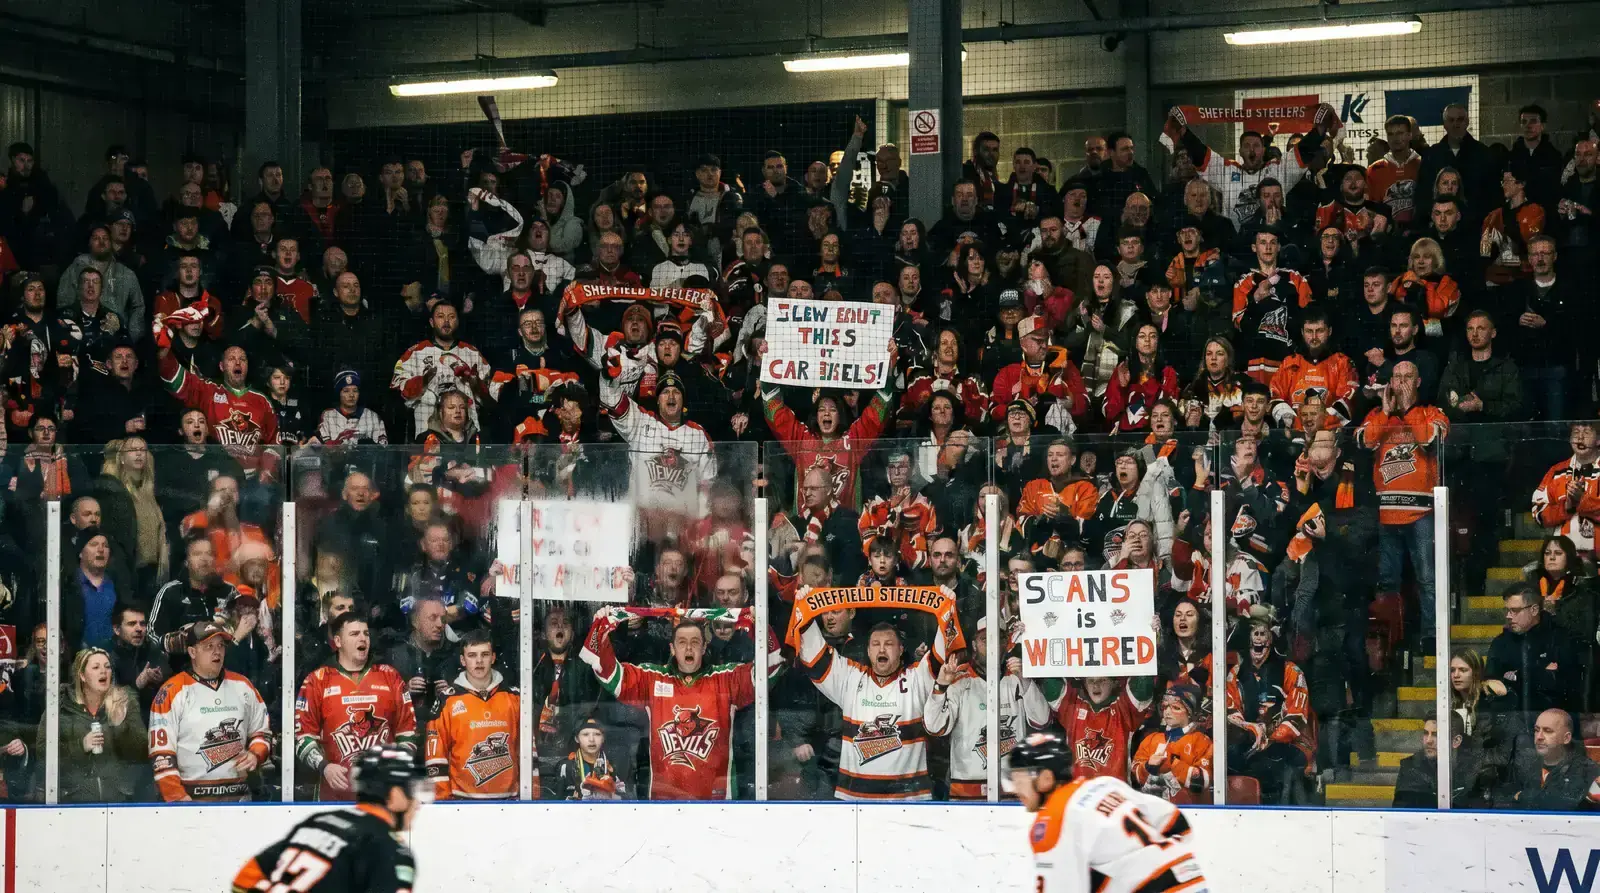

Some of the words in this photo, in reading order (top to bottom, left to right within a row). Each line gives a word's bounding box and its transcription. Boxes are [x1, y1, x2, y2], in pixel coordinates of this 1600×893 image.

[1198, 107, 1252, 119] SHEFFIELD
[1256, 106, 1306, 118] STEELERS
[583, 284, 646, 297] SHEFFIELD
[769, 359, 809, 380] CAR
[807, 587, 874, 611] SHEFFIELD
[880, 587, 945, 609] STEELERS
[1025, 573, 1131, 604] SCANS
[1077, 608, 1097, 628] is
[899, 677, 908, 694] C
[150, 728, 168, 749] 19
[427, 738, 438, 757] 17
[660, 727, 720, 762] DEVILS
[1076, 743, 1113, 765] DEVILS
